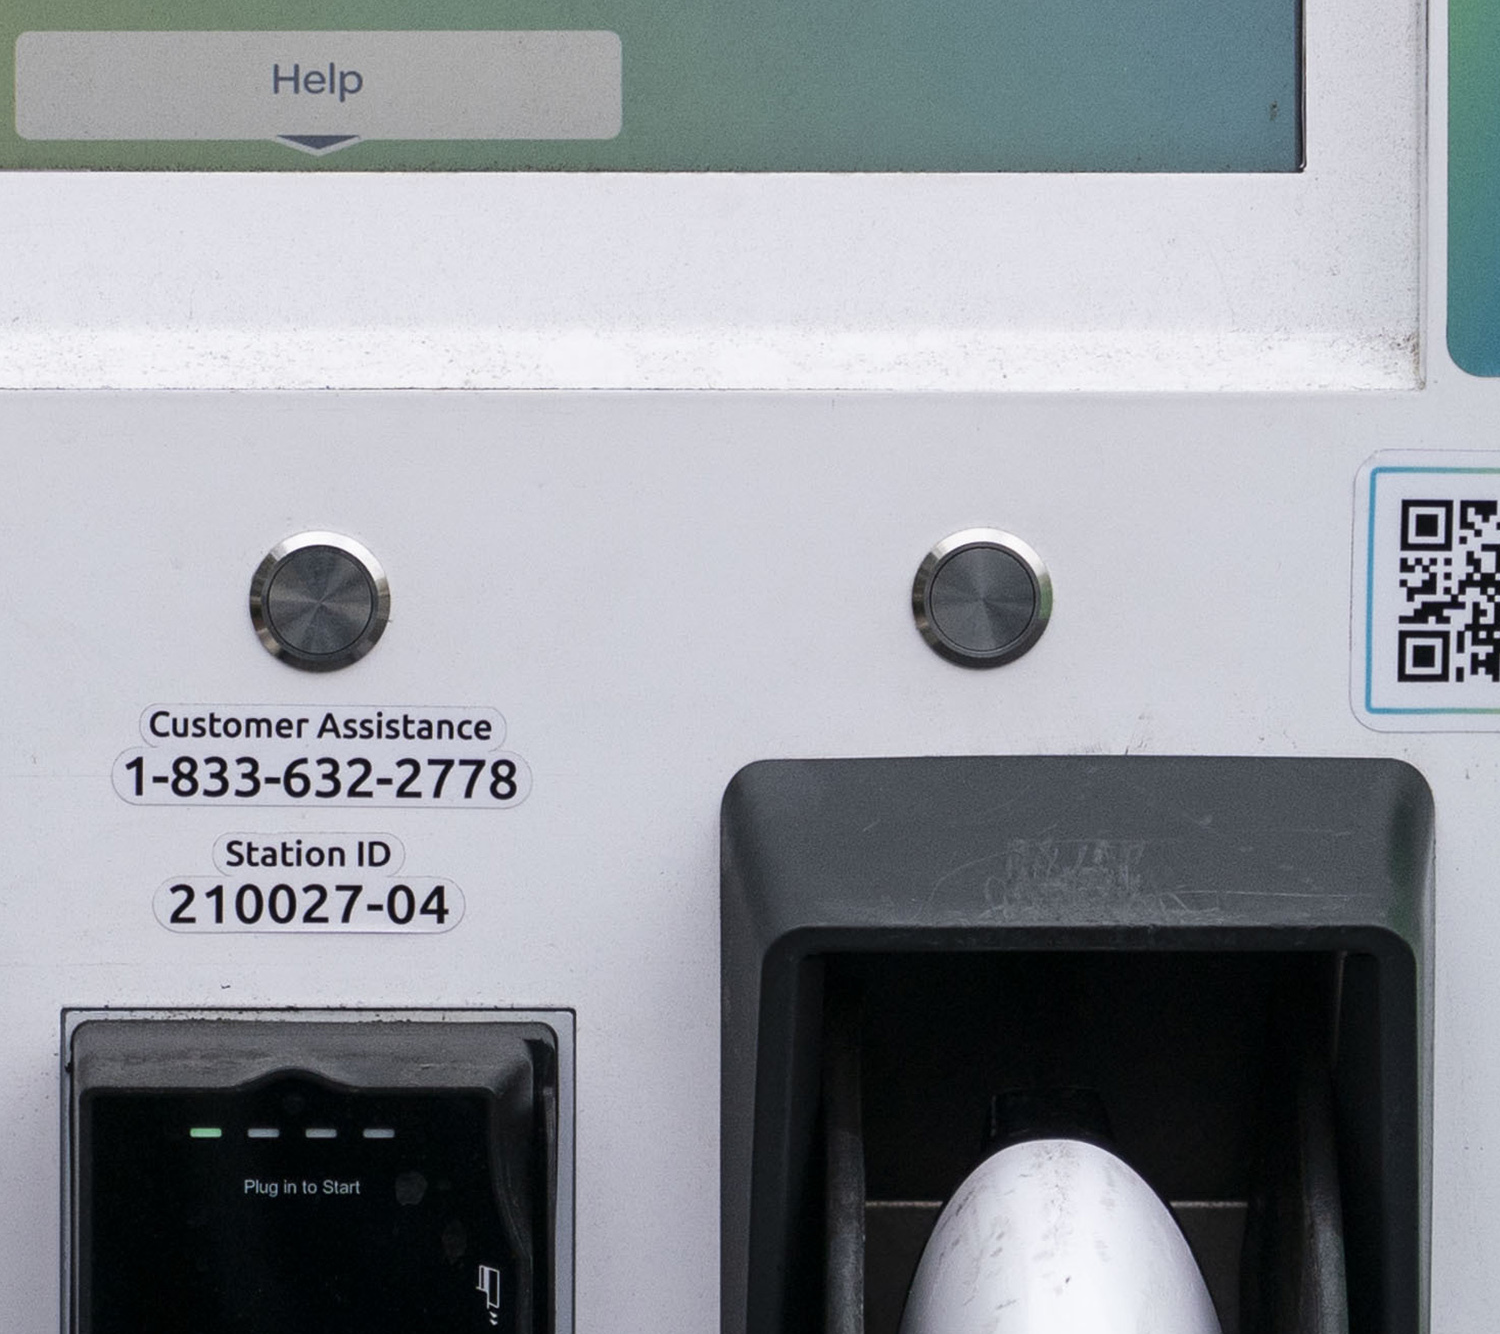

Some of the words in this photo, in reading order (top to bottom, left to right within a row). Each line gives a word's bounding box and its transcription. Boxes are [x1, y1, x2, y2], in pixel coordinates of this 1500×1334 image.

[273, 62, 363, 103] Help
[149, 710, 310, 739] Customer
[316, 711, 492, 741] Assistance
[125, 755, 517, 801] 1-833-632-2778
[226, 839, 346, 868] Station
[357, 840, 391, 868] ID
[169, 883, 449, 925] 210027-04
[243, 1179, 279, 1198] Plug
[283, 1179, 298, 1194] in
[301, 1180, 318, 1195] to
[322, 1179, 361, 1195] Start
